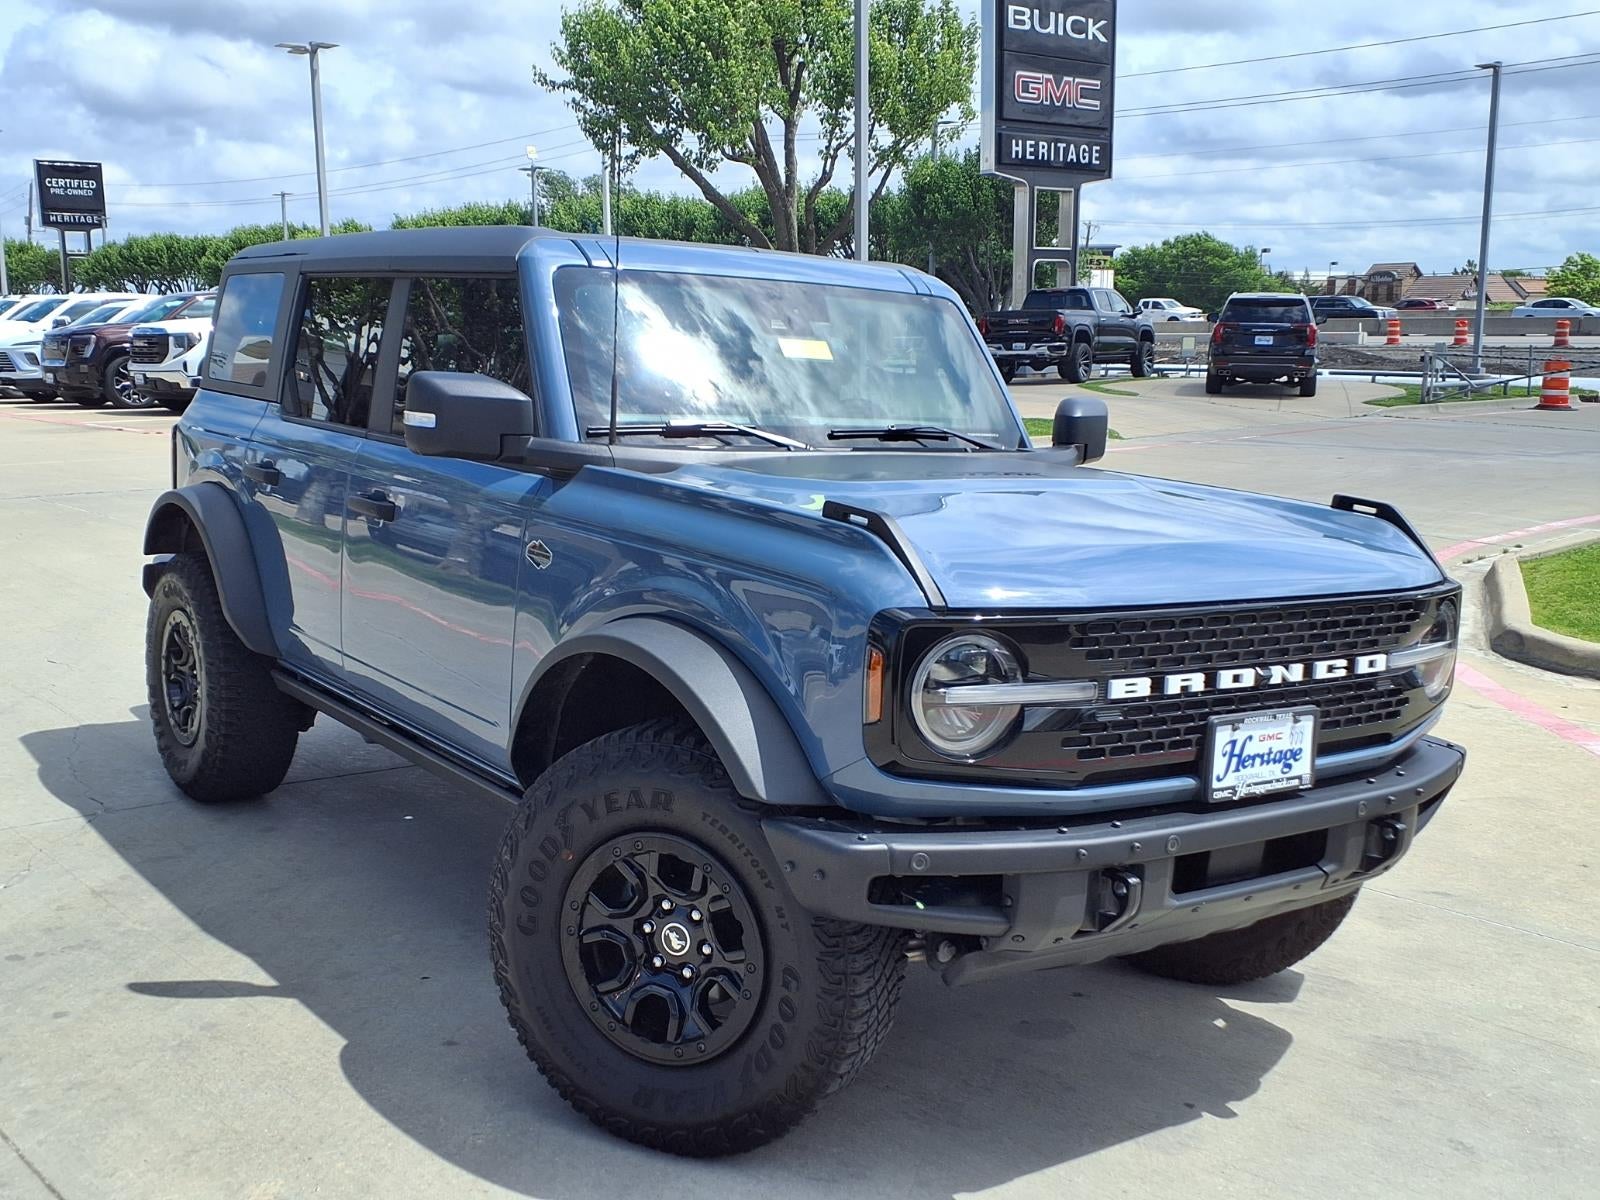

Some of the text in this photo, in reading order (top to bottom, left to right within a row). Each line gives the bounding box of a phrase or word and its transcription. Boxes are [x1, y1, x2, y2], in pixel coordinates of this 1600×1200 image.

[1008, 5, 1108, 43] BUICK
[1014, 70, 1101, 111] GMC
[1011, 139, 1100, 165] HERITAGE
[45, 178, 97, 189] CERTIFIED
[50, 187, 93, 196] PRE-OWNED
[49, 214, 100, 224] HERITAGE
[1086, 258, 1108, 266] EST
[1107, 653, 1388, 700] BRONCO
[1258, 732, 1284, 742] GMC
[1215, 734, 1303, 783] Heritage
[701, 811, 776, 891] TERRITORY
